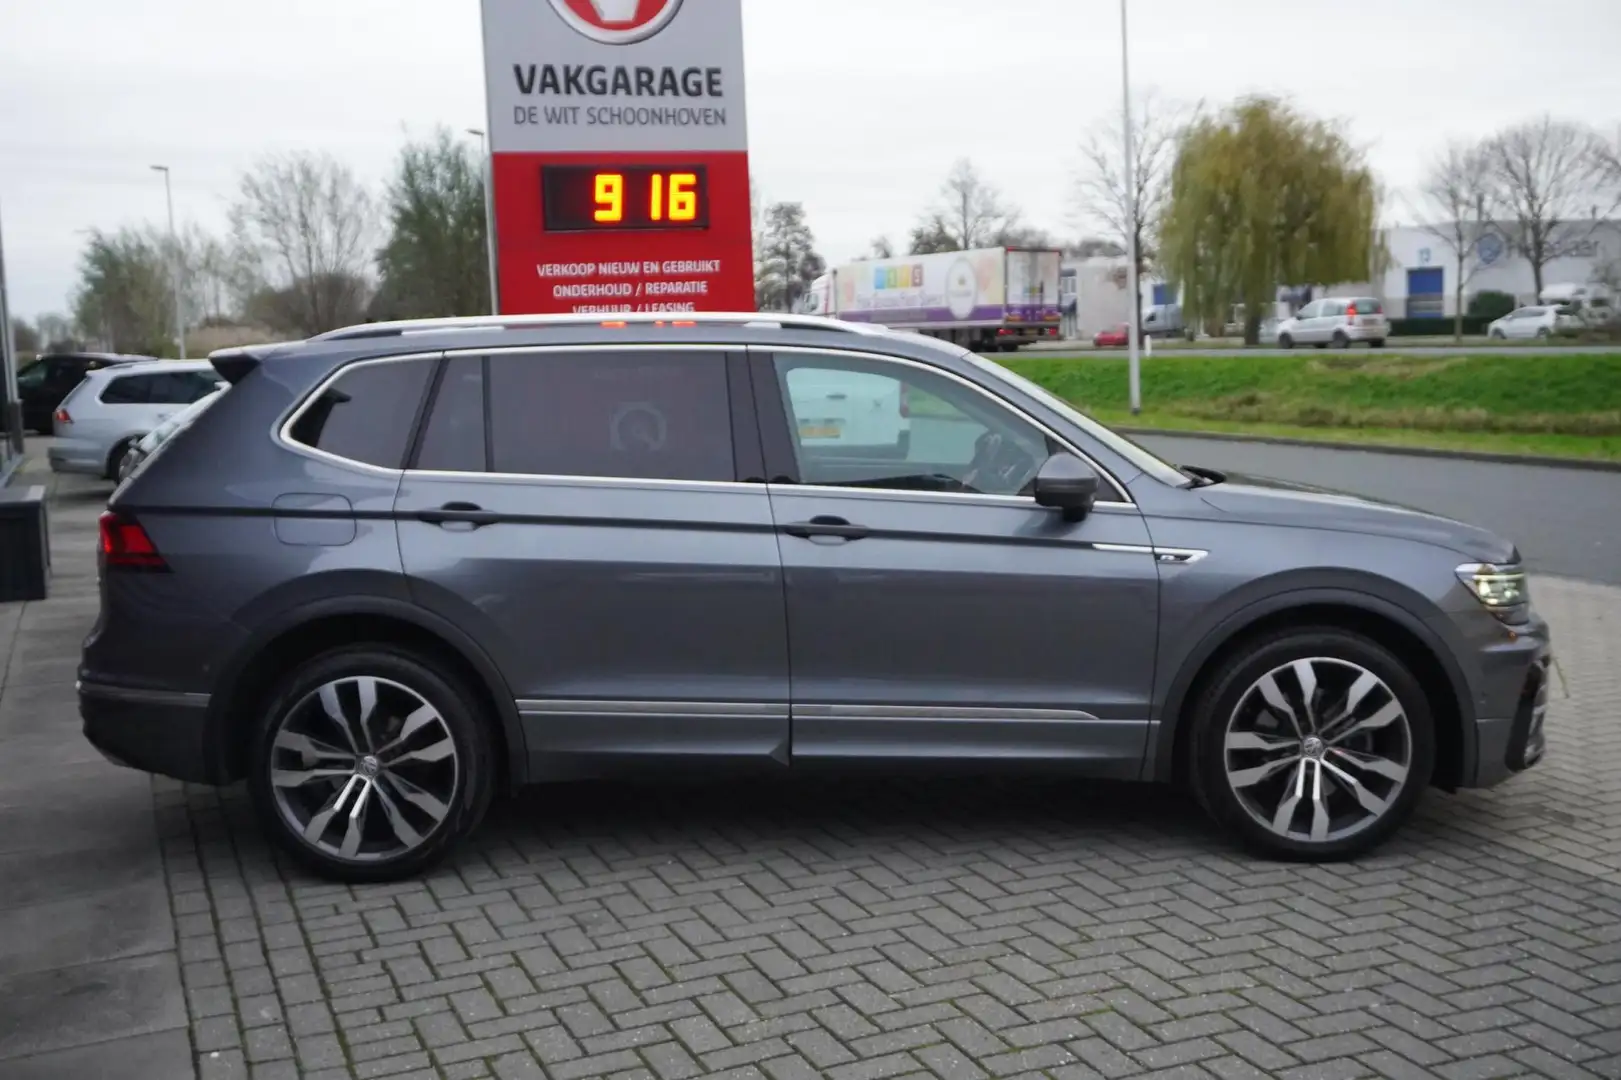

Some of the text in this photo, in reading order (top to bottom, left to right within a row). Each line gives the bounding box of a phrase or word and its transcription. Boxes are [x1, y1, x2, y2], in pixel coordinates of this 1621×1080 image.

[513, 63, 723, 97] VAKGARAGE
[513, 106, 726, 126] DE WIT SCHOONHOVEN
[651, 174, 696, 221] 16
[537, 260, 720, 277] VERKOOP NIEUW EN GEBRUIKT
[553, 280, 708, 297] ONDERHOUD / REPARATIE
[645, 302, 695, 313] LEASING
